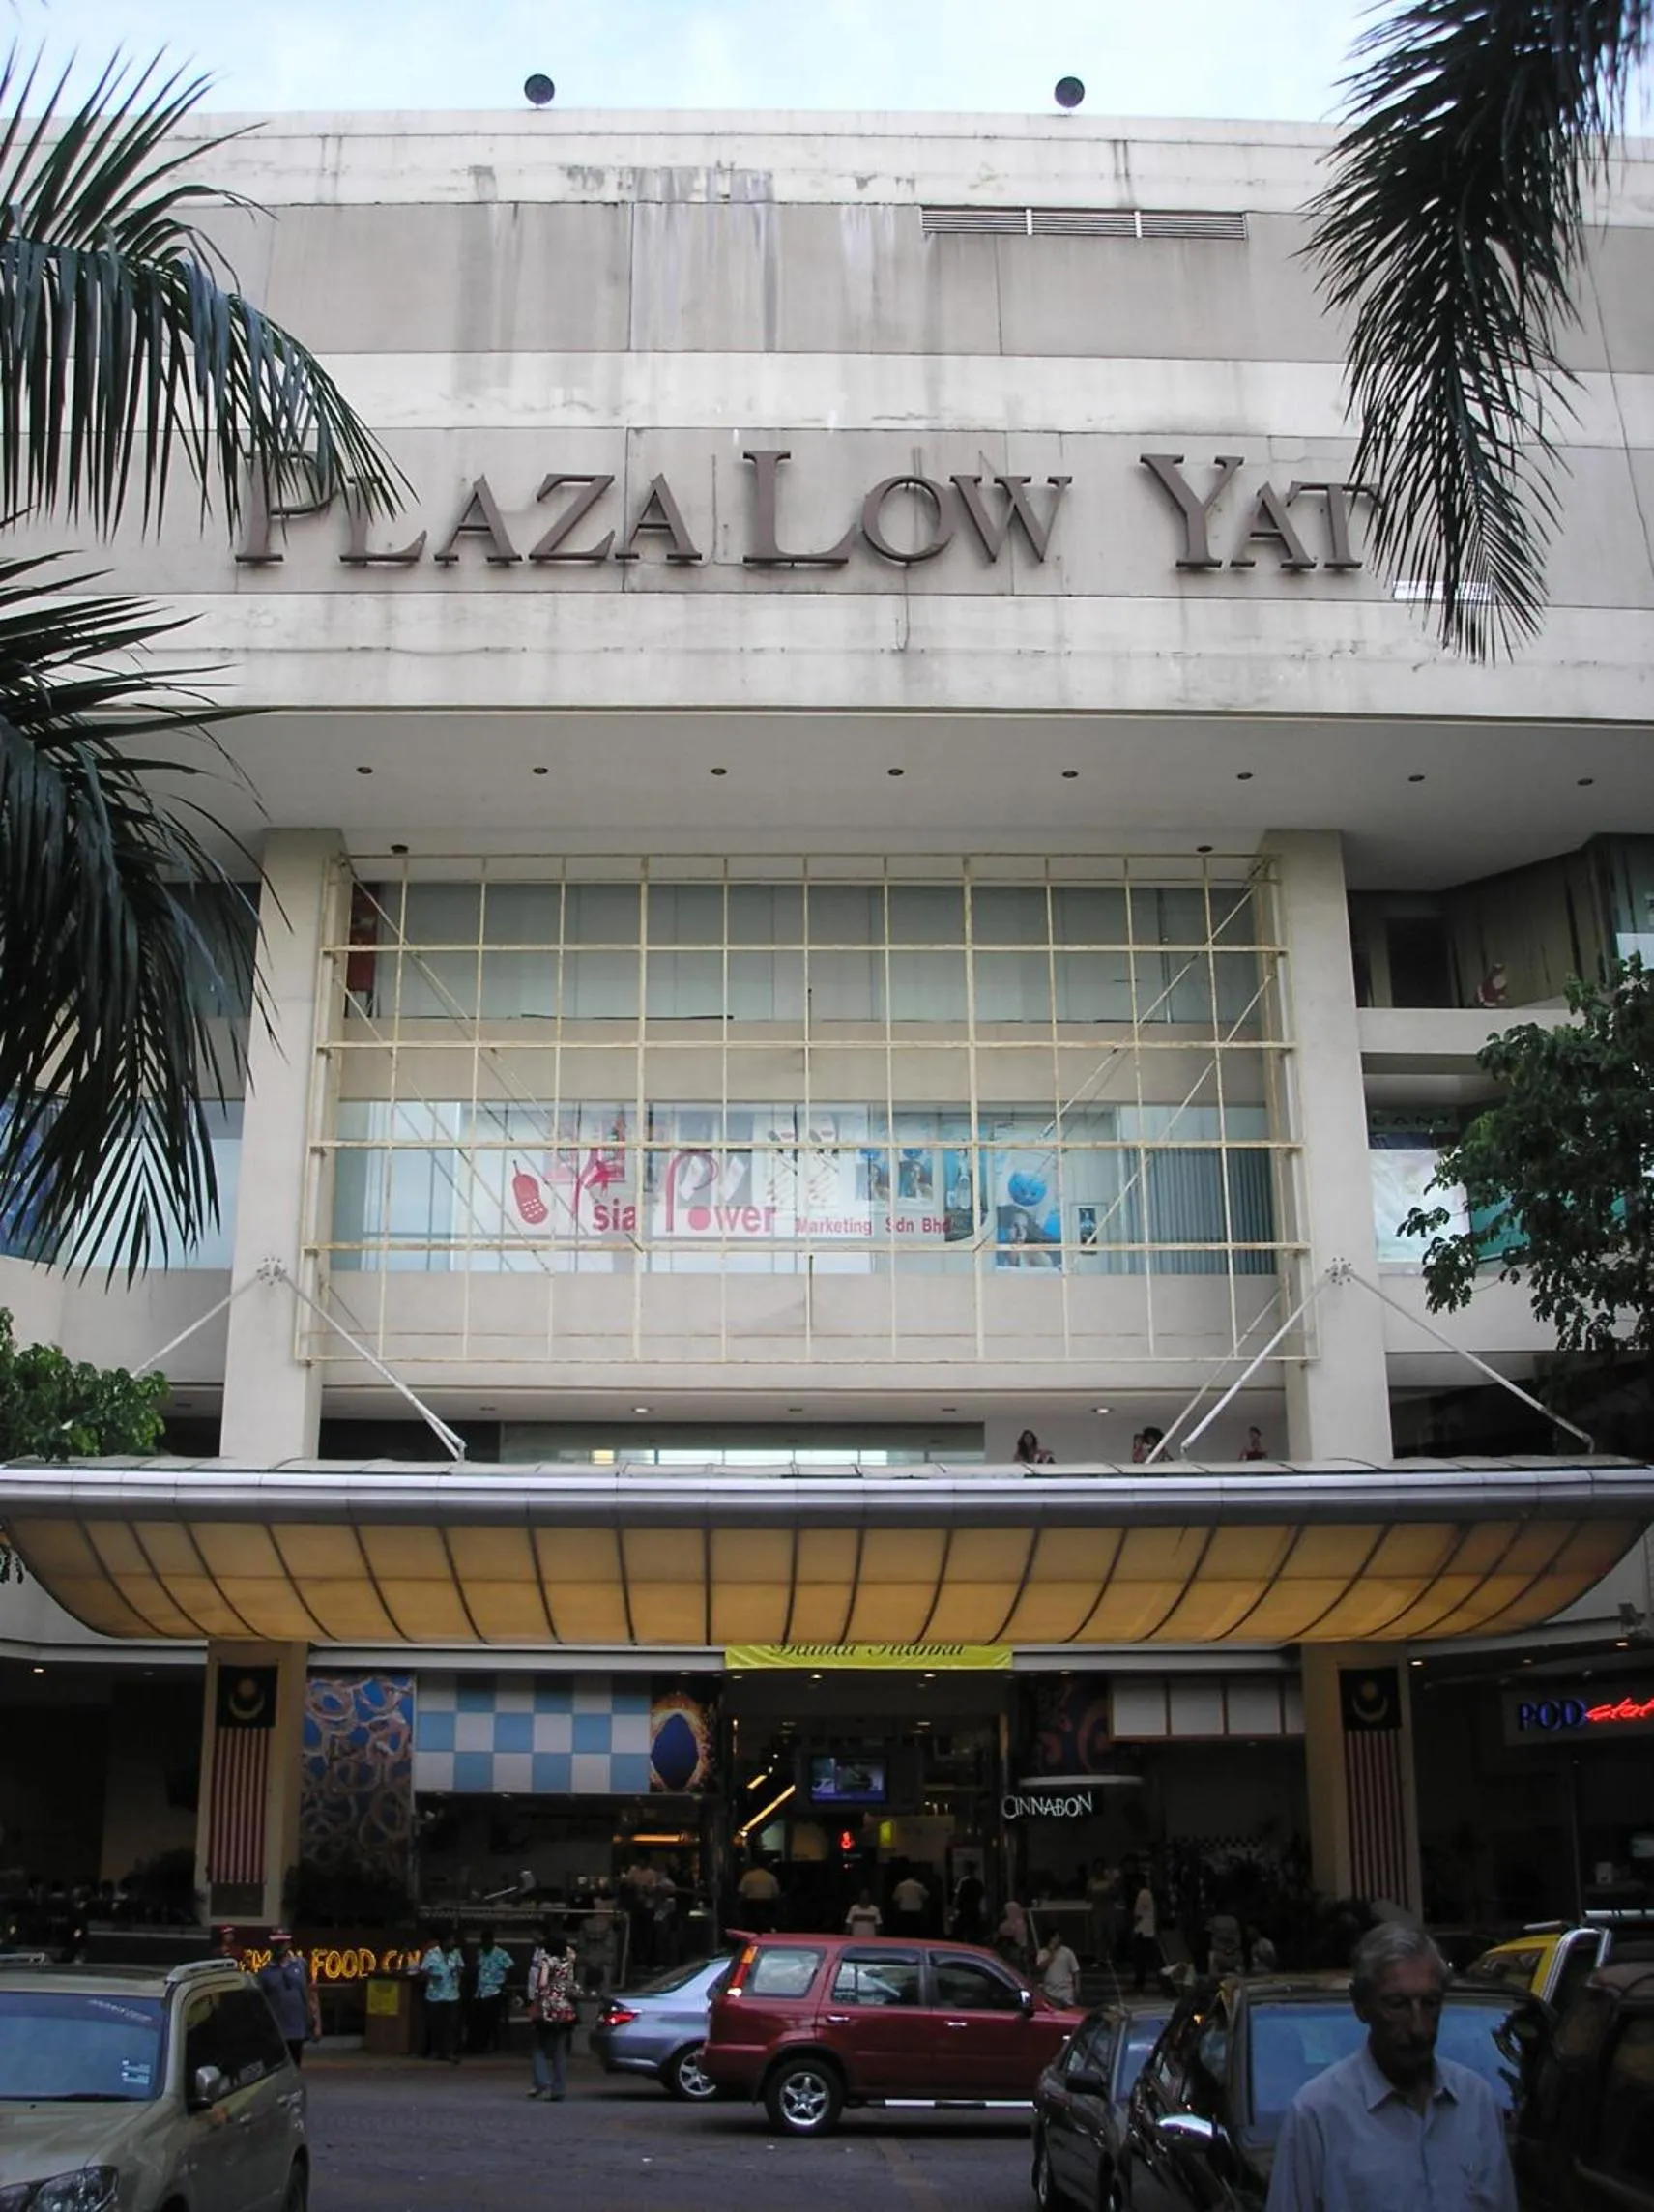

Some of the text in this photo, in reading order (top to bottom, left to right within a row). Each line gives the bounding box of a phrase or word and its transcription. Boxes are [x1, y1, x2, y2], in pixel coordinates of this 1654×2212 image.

[235, 449, 1381, 568] PLAZA LOW YAT
[795, 1217, 873, 1237] Marketing
[885, 1217, 914, 1233] Sdn
[921, 1217, 952, 1234] Bhd
[1517, 1697, 1587, 1732] POD
[1001, 1791, 1093, 1819] CINNABON
[310, 1947, 376, 1980] FOOD
